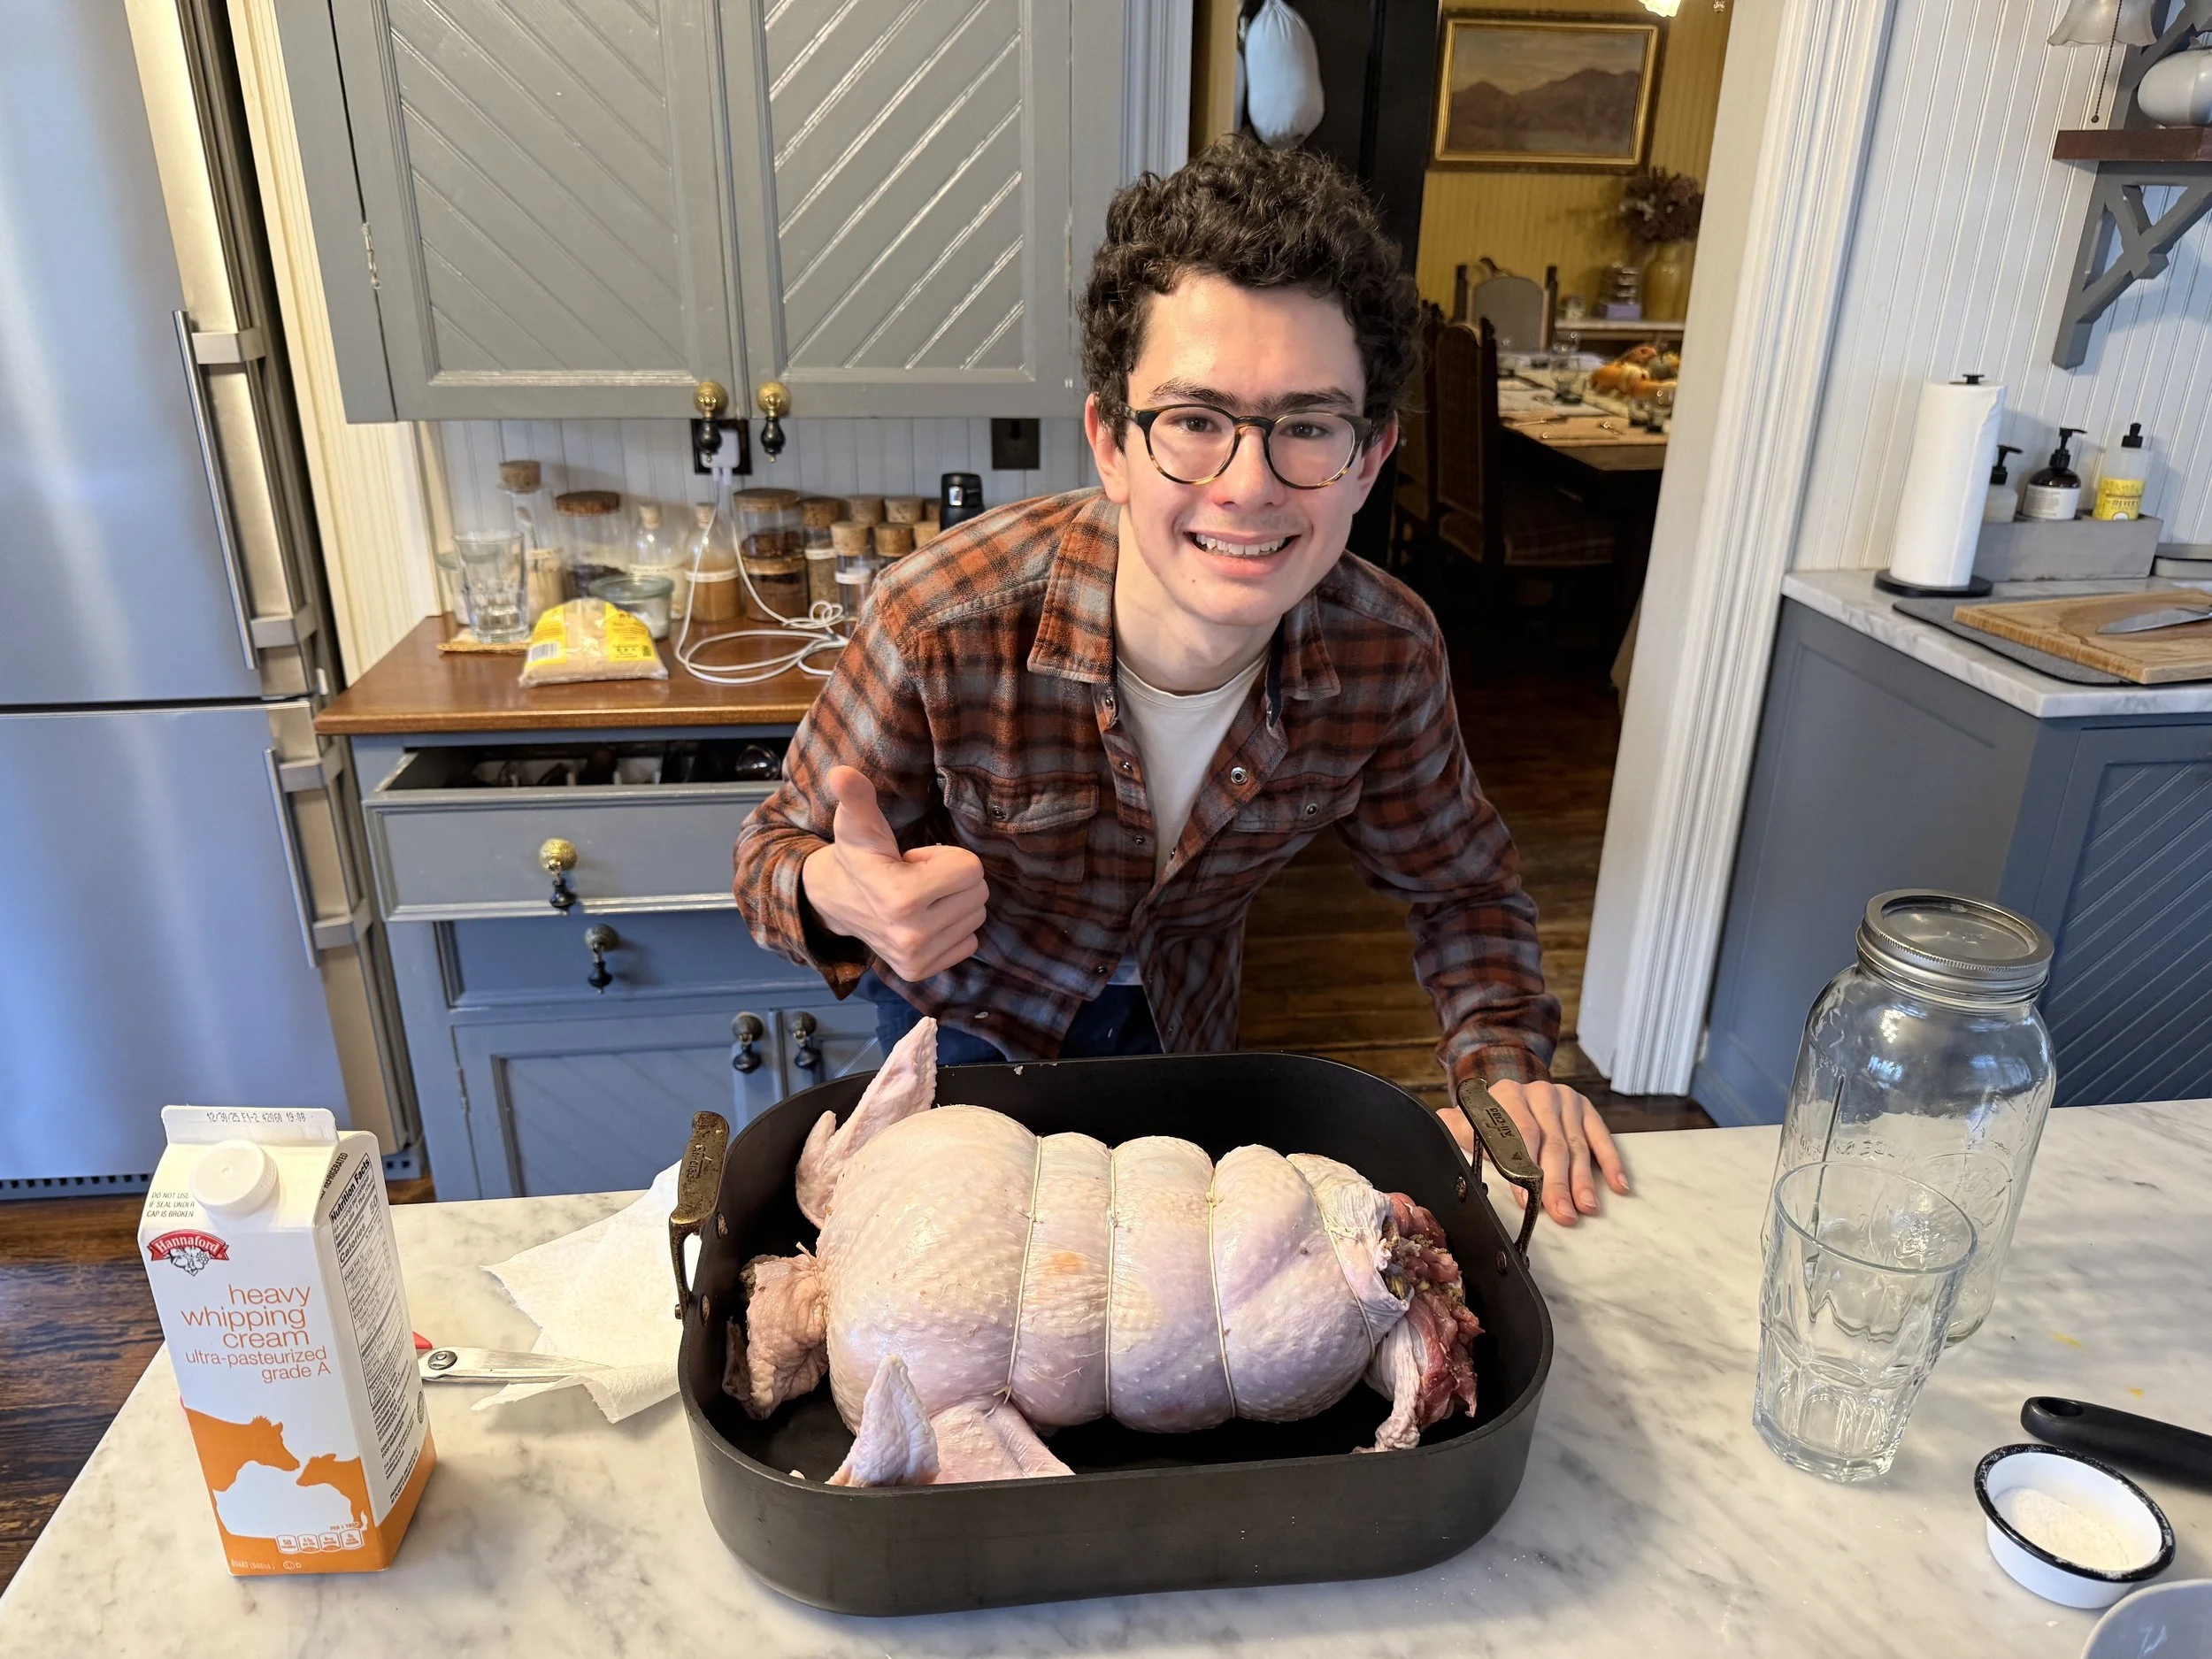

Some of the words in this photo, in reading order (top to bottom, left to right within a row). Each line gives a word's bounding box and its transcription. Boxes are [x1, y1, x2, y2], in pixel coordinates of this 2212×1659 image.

[331, 1182, 356, 1223] Nutrition
[354, 1158, 370, 1185] Facts
[340, 1223, 365, 1263] Calories
[369, 1194, 378, 1215] 50
[155, 1235, 220, 1256] Hannaford
[228, 1284, 311, 1307] heavy
[180, 1306, 306, 1332] whipping
[223, 1330, 310, 1348] cream
[185, 1346, 327, 1368] ultra-pasteurized
[261, 1364, 311, 1384] grade
[318, 1361, 331, 1376] A
